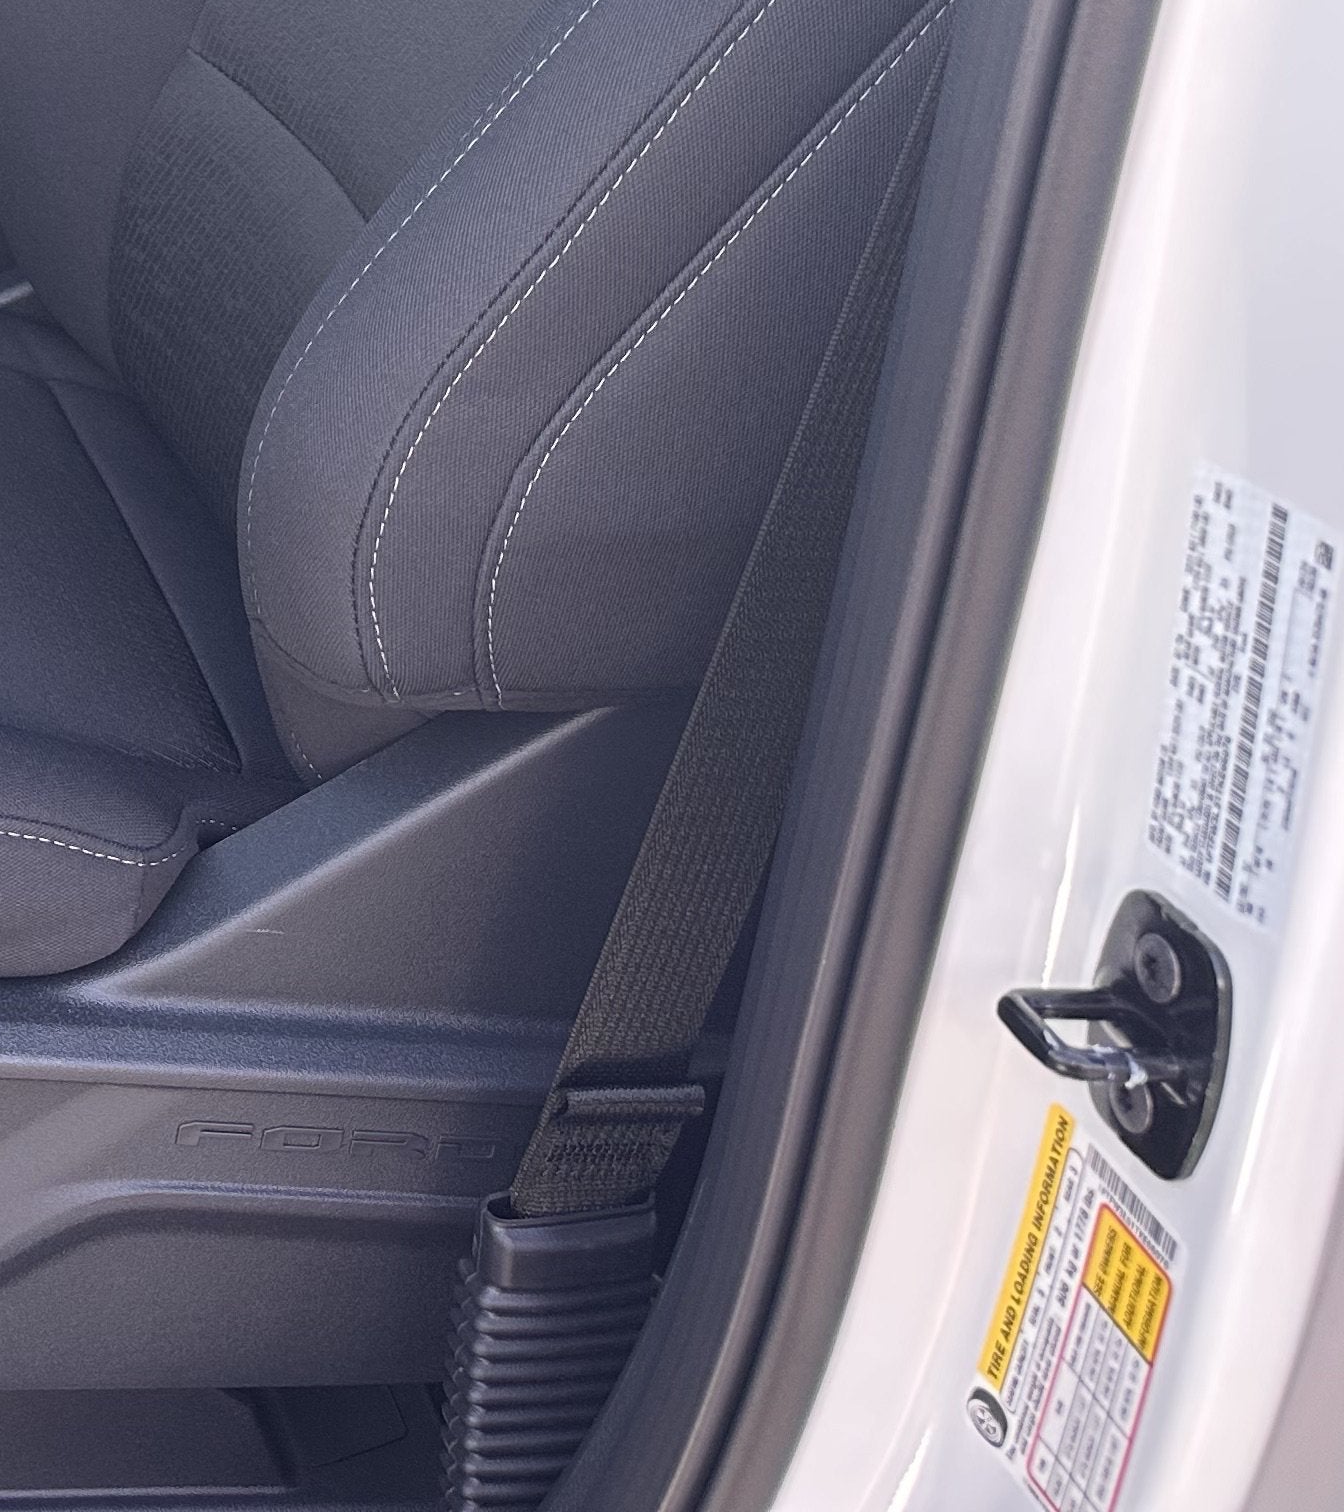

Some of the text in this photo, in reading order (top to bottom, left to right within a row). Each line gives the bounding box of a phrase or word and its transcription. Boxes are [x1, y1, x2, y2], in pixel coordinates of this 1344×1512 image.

[174, 1119, 503, 1161] FORD
[986, 1342, 1006, 1380] TIRE
[1002, 1302, 1018, 1339] AND
[1012, 1235, 1039, 1305] LOADING
[1032, 1114, 1070, 1232] INFORMATION
